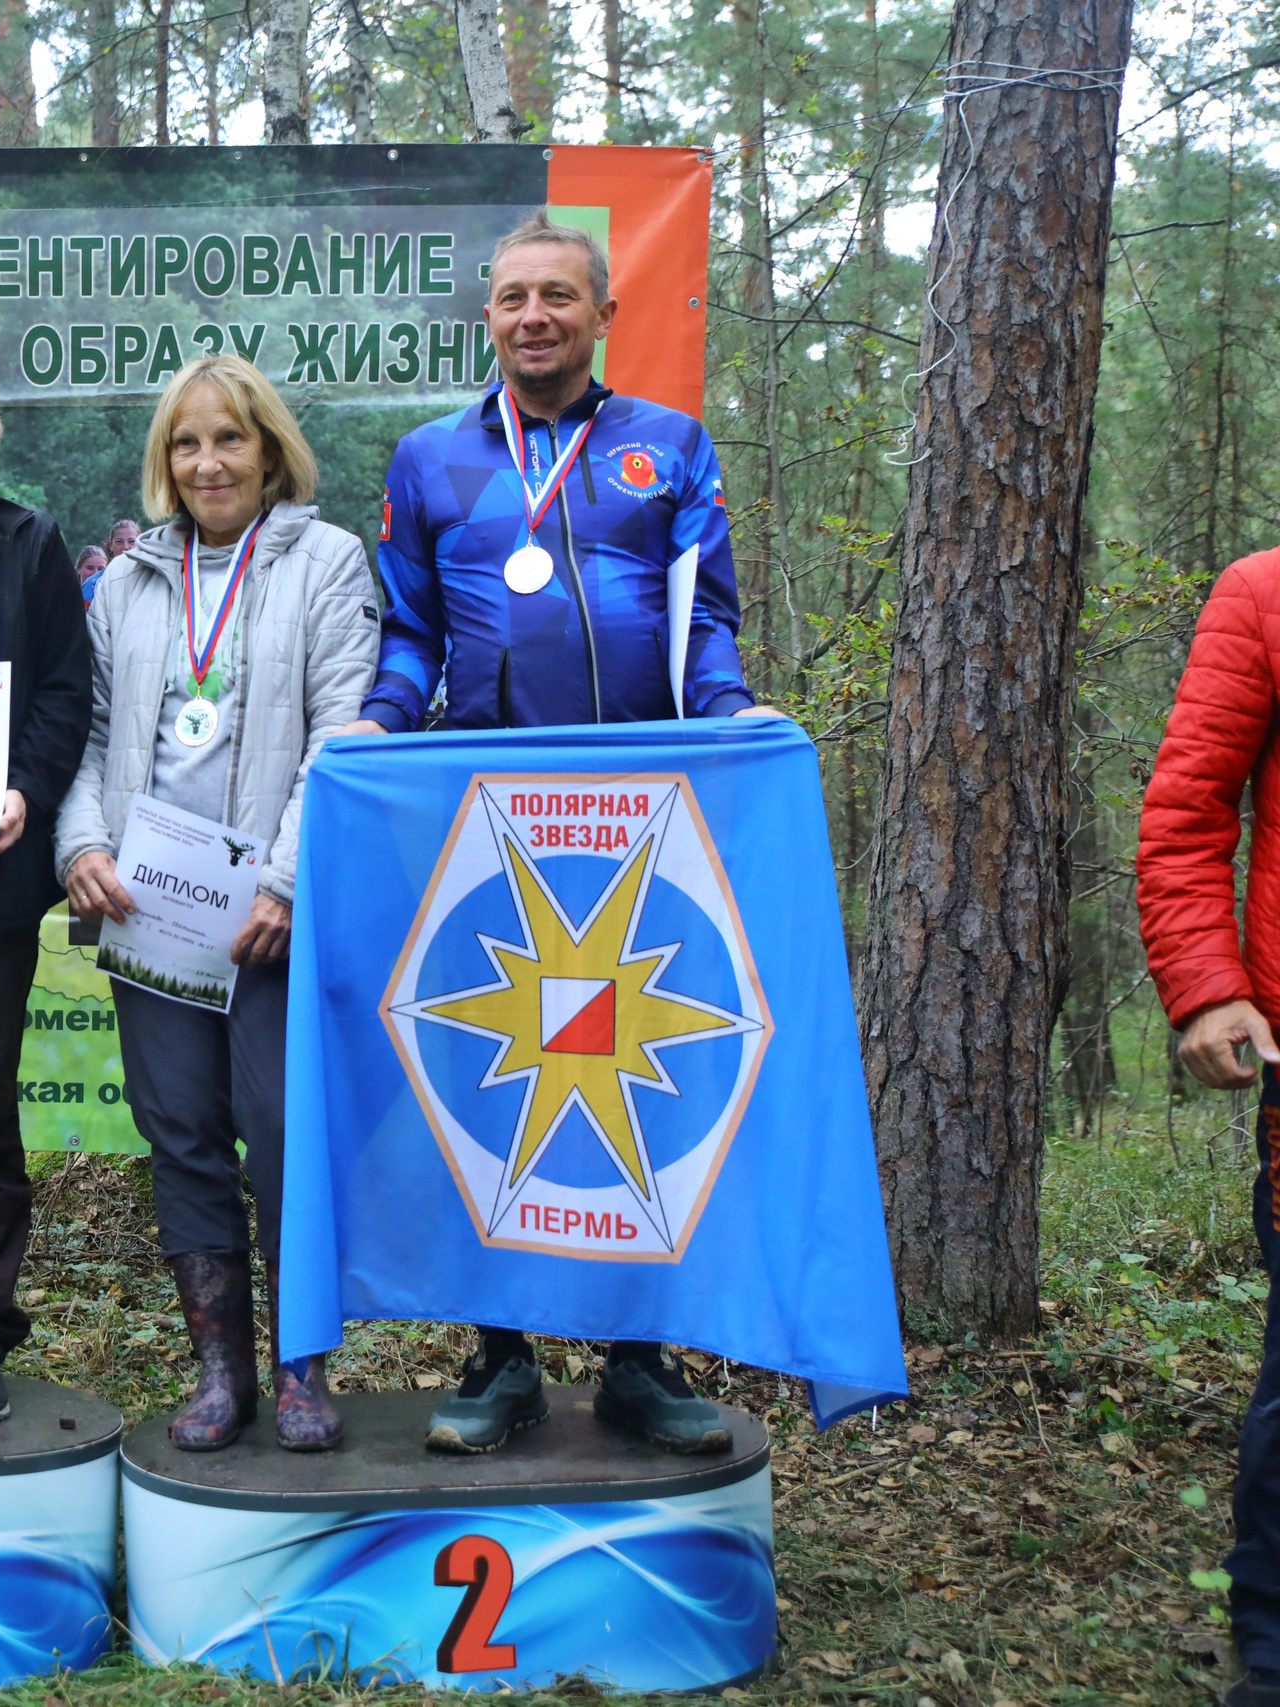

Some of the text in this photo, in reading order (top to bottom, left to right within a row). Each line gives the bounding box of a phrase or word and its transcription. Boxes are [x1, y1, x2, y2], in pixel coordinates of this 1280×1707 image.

[288, 322, 503, 383] ЖИЗНИ
[529, 433, 541, 477] VICTORY
[606, 442, 665, 458] ПЕРМСКИЙ КРАЙ
[607, 477, 673, 499] ОРИЕНТИРОВАНИЕ
[510, 794, 649, 817] ПОЛЯРНАЯ
[529, 825, 629, 851] ЗВЕЗДА
[132, 864, 229, 910] ДИПЛОМ
[519, 1203, 638, 1240] ПЕРМЬ
[434, 1534, 516, 1673] 2
